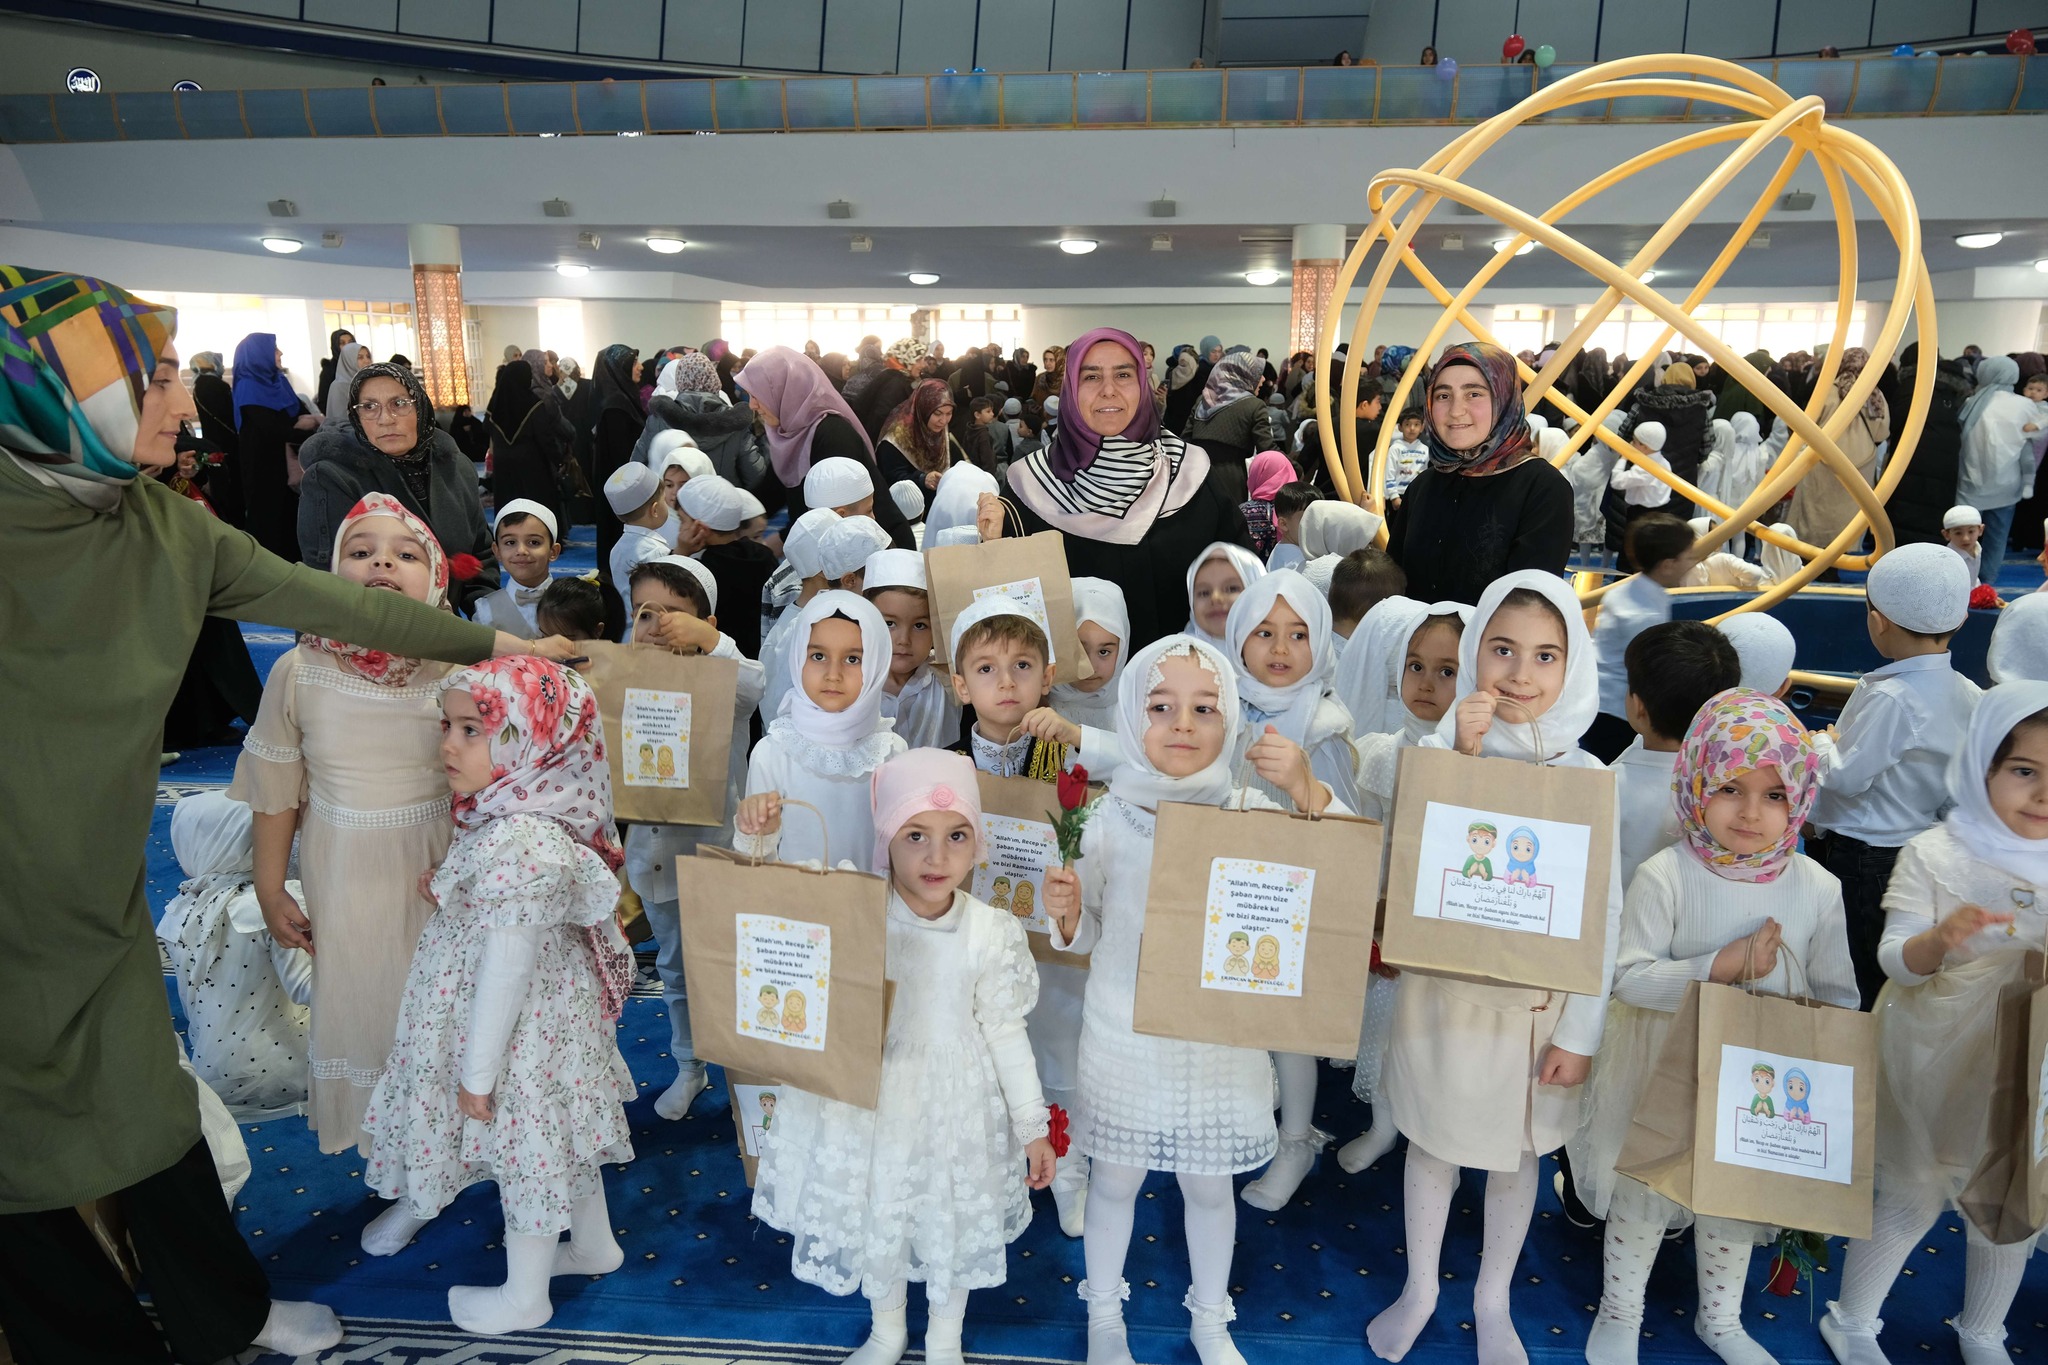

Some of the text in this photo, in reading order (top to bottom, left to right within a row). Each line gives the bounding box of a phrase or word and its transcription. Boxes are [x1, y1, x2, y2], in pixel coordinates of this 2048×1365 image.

[1012, 864, 1042, 872] Ramazan'a
[1262, 884, 1283, 892] Recep
[1237, 902, 1269, 911] mübârek
[1251, 914, 1289, 924] Ramazan'a
[785, 940, 805, 950] Recep
[778, 970, 813, 979] Ramazan'a
